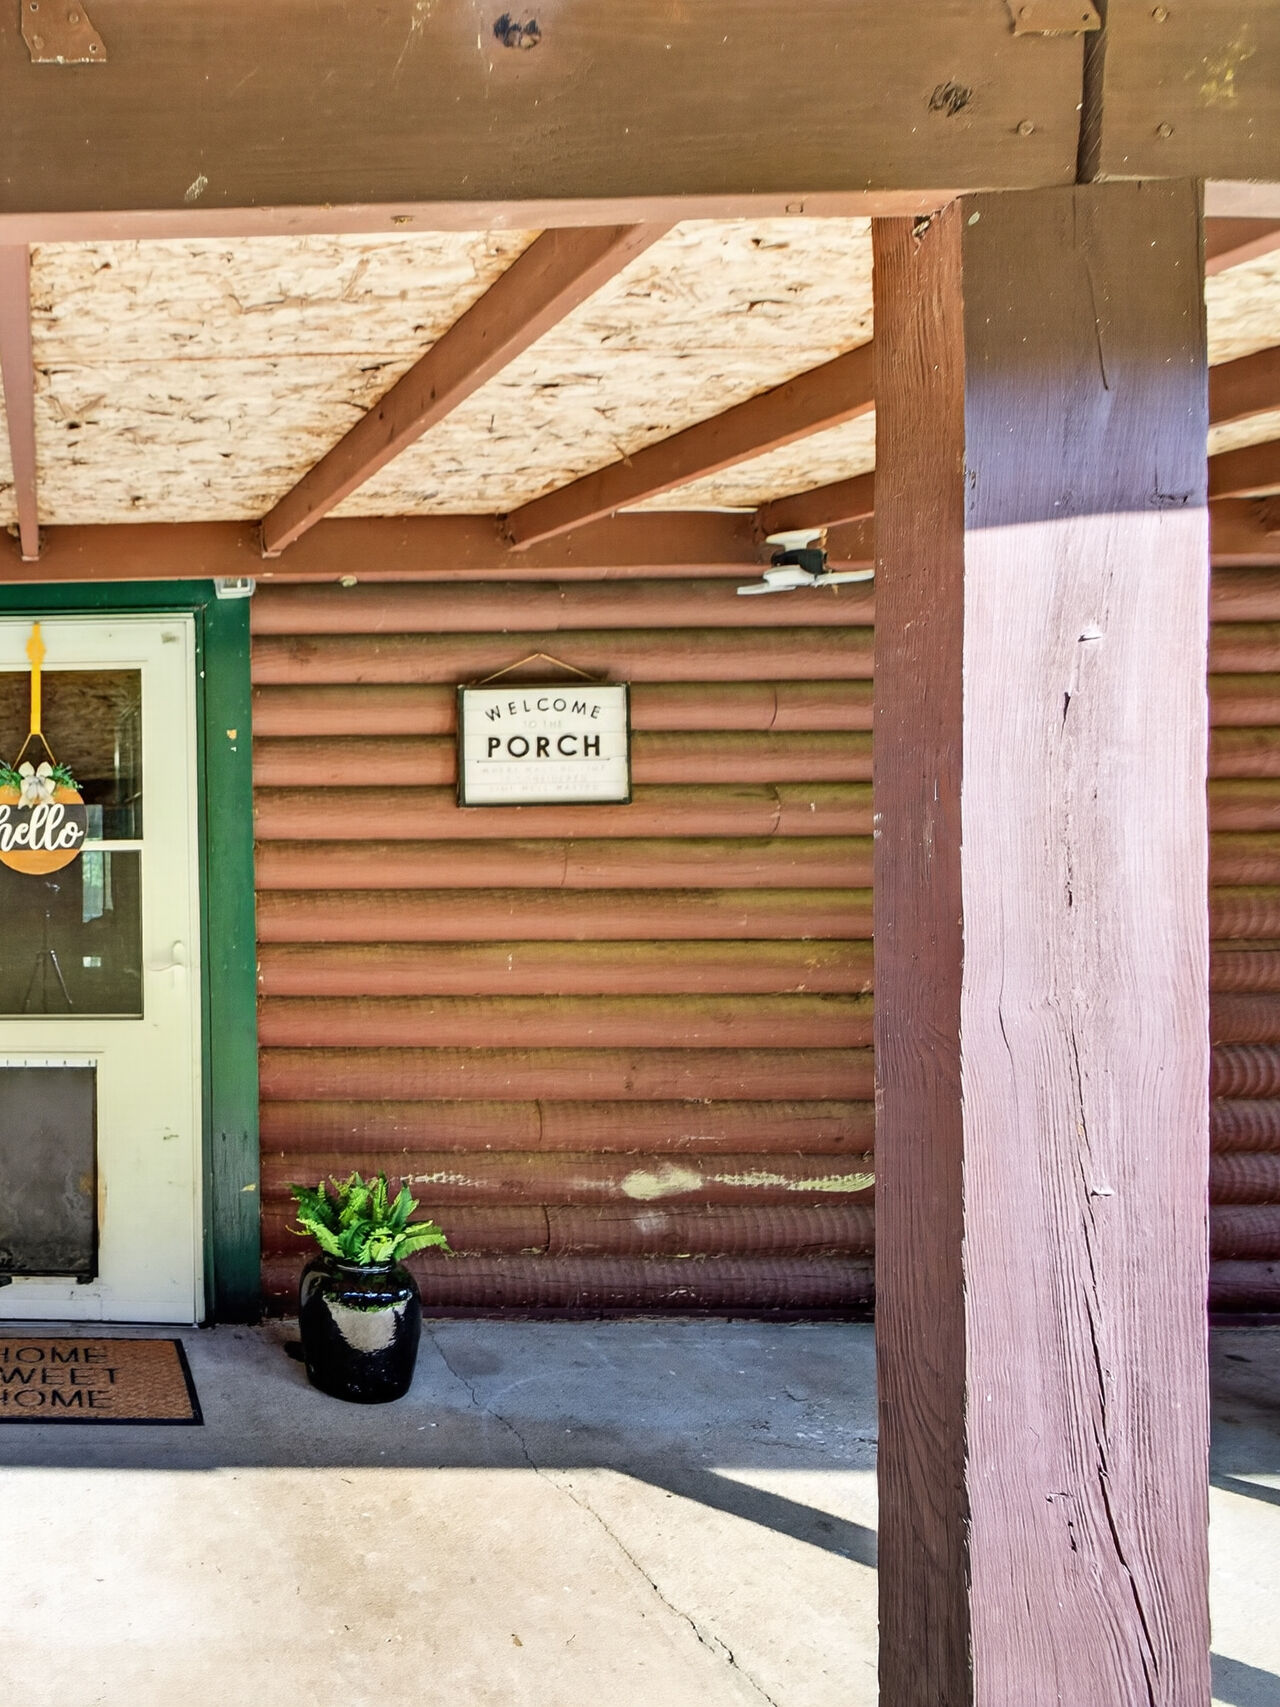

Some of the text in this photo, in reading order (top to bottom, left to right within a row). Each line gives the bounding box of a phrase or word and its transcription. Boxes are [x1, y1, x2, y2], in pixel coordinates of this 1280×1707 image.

[485, 698, 602, 722] WELCOME
[522, 720, 563, 728] TO THE
[487, 735, 601, 758] PORCH
